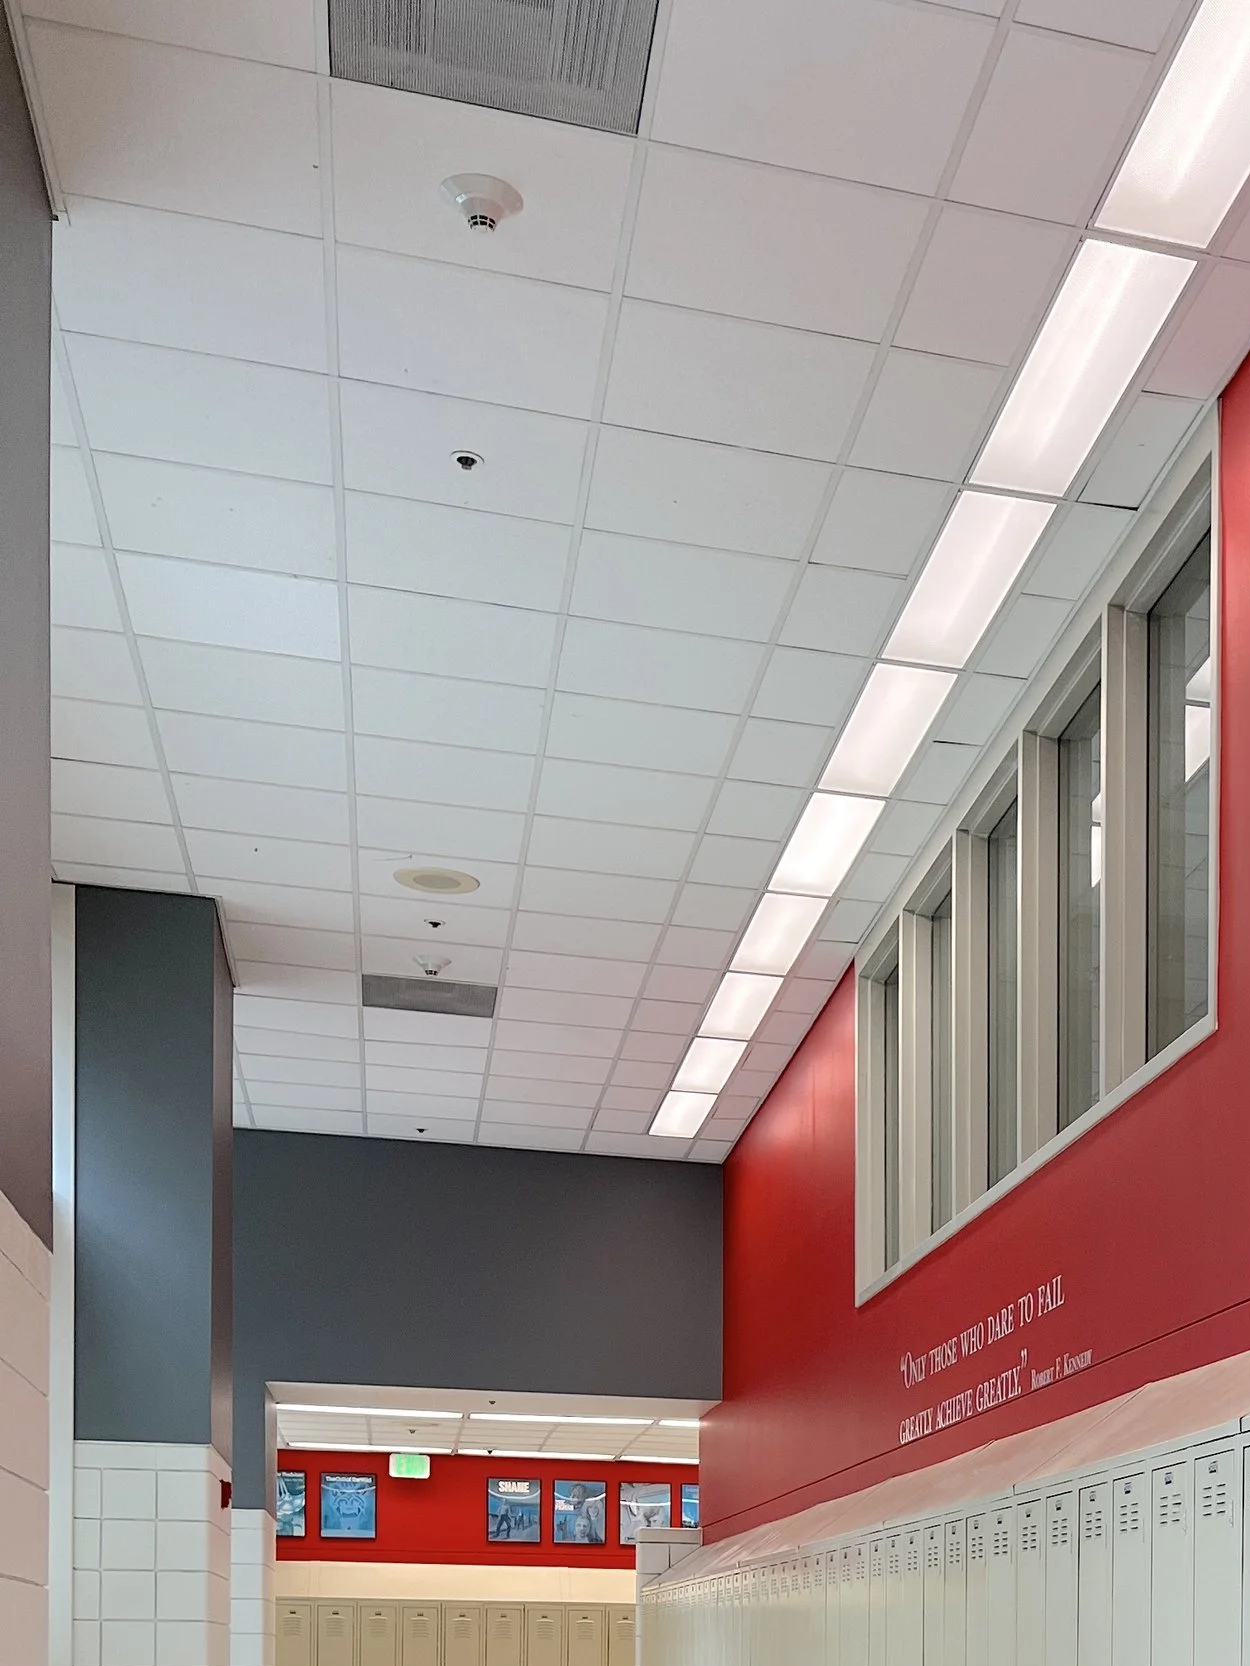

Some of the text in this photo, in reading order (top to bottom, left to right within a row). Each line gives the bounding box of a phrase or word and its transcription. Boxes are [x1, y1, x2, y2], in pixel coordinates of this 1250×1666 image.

[928, 1336, 958, 1376] THOSE
[959, 1321, 984, 1358] WHO
[987, 1303, 1015, 1345] DARE
[1017, 1292, 1034, 1328] TO
[1037, 1274, 1065, 1318] FAIL
[899, 1407, 934, 1445] GREATLY
[935, 1388, 973, 1431] ACHIEVE
